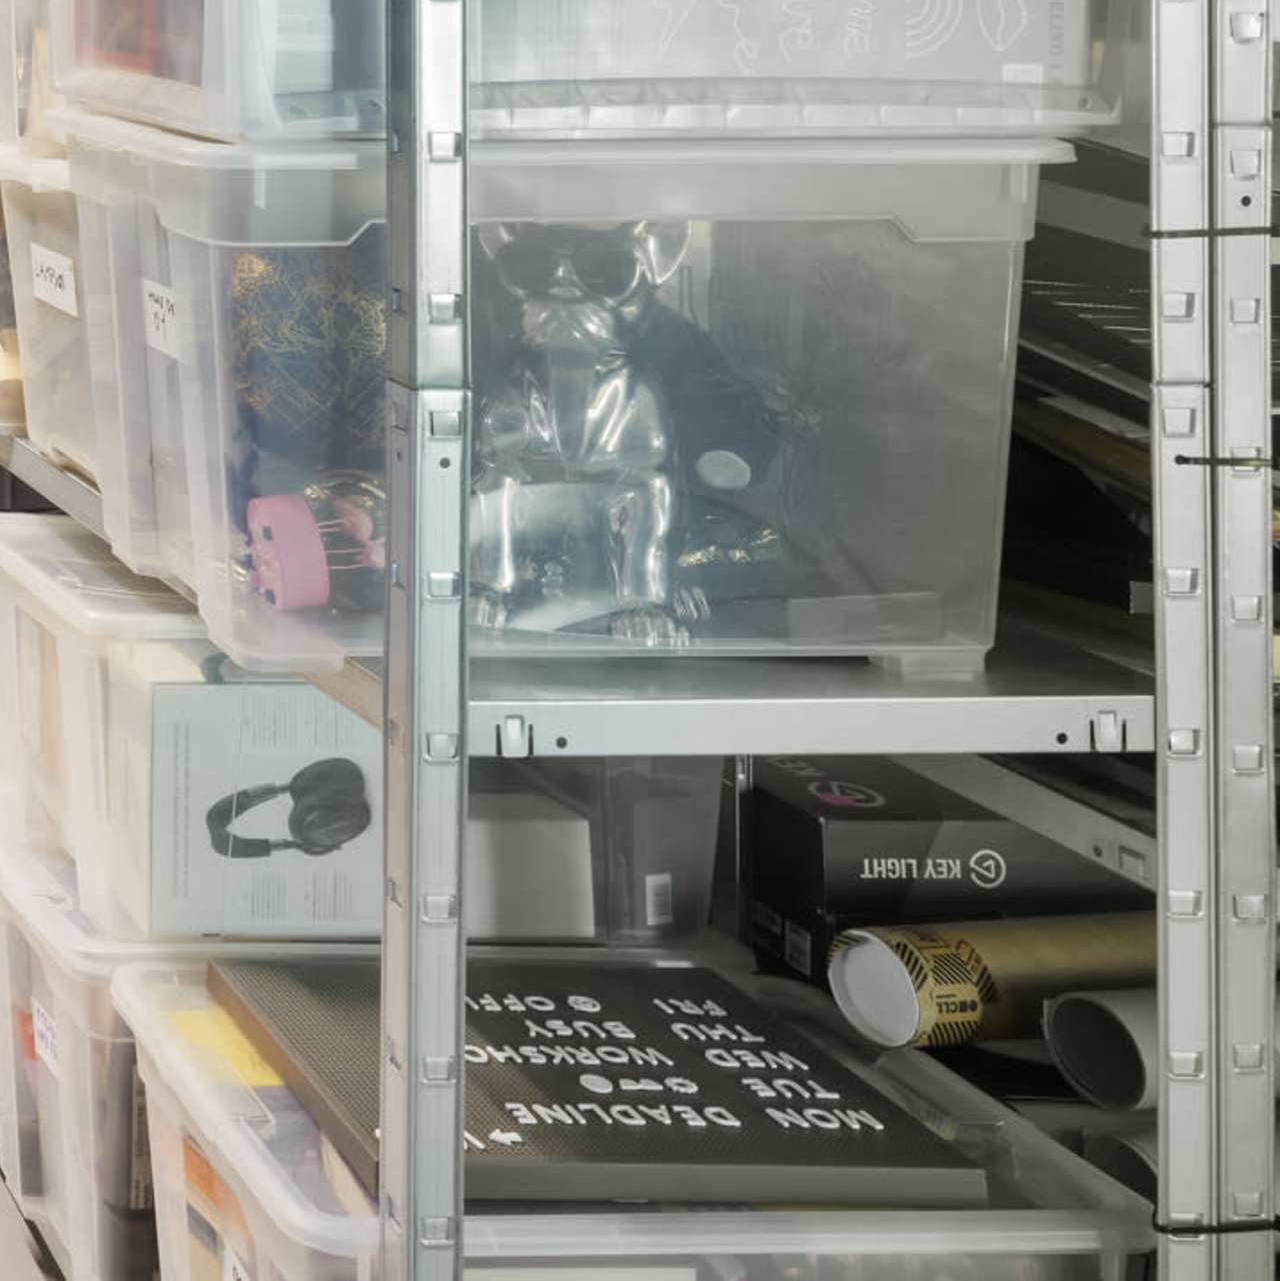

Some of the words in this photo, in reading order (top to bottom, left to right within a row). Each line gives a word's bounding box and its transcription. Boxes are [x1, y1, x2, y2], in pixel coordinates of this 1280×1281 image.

[860, 858, 918, 879] LIGHT
[922, 858, 962, 879] KEY
[652, 997, 729, 1017] FRI
[523, 1018, 637, 1039] BUSY
[670, 1021, 766, 1043] THU
[464, 1045, 675, 1067] WORKSHO
[704, 1048, 810, 1072] WED
[741, 1077, 840, 1100] TUE
[504, 1102, 742, 1128] DEADLINE
[764, 1106, 885, 1131] MON
